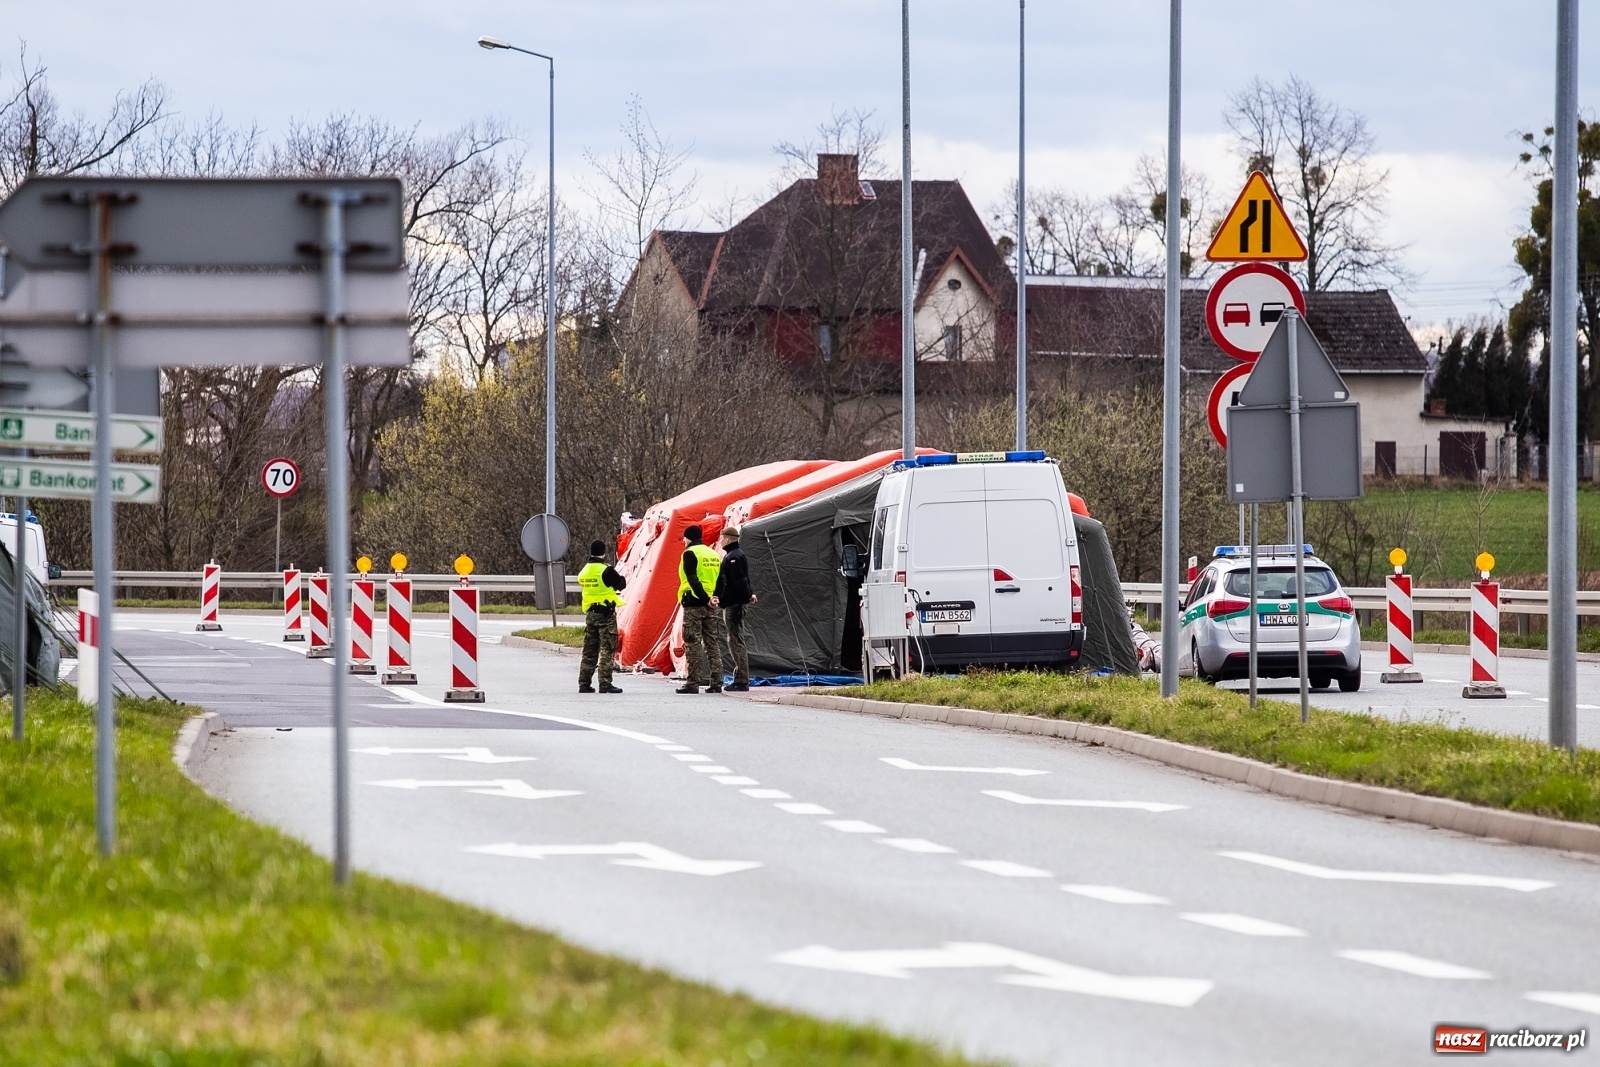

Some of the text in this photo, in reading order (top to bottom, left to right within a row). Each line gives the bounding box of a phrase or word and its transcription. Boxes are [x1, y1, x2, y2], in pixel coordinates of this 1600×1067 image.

[55, 422, 92, 441] Ban
[270, 468, 294, 486] 70
[927, 610, 970, 620] HWA B562
[1265, 616, 1285, 625] HWA
